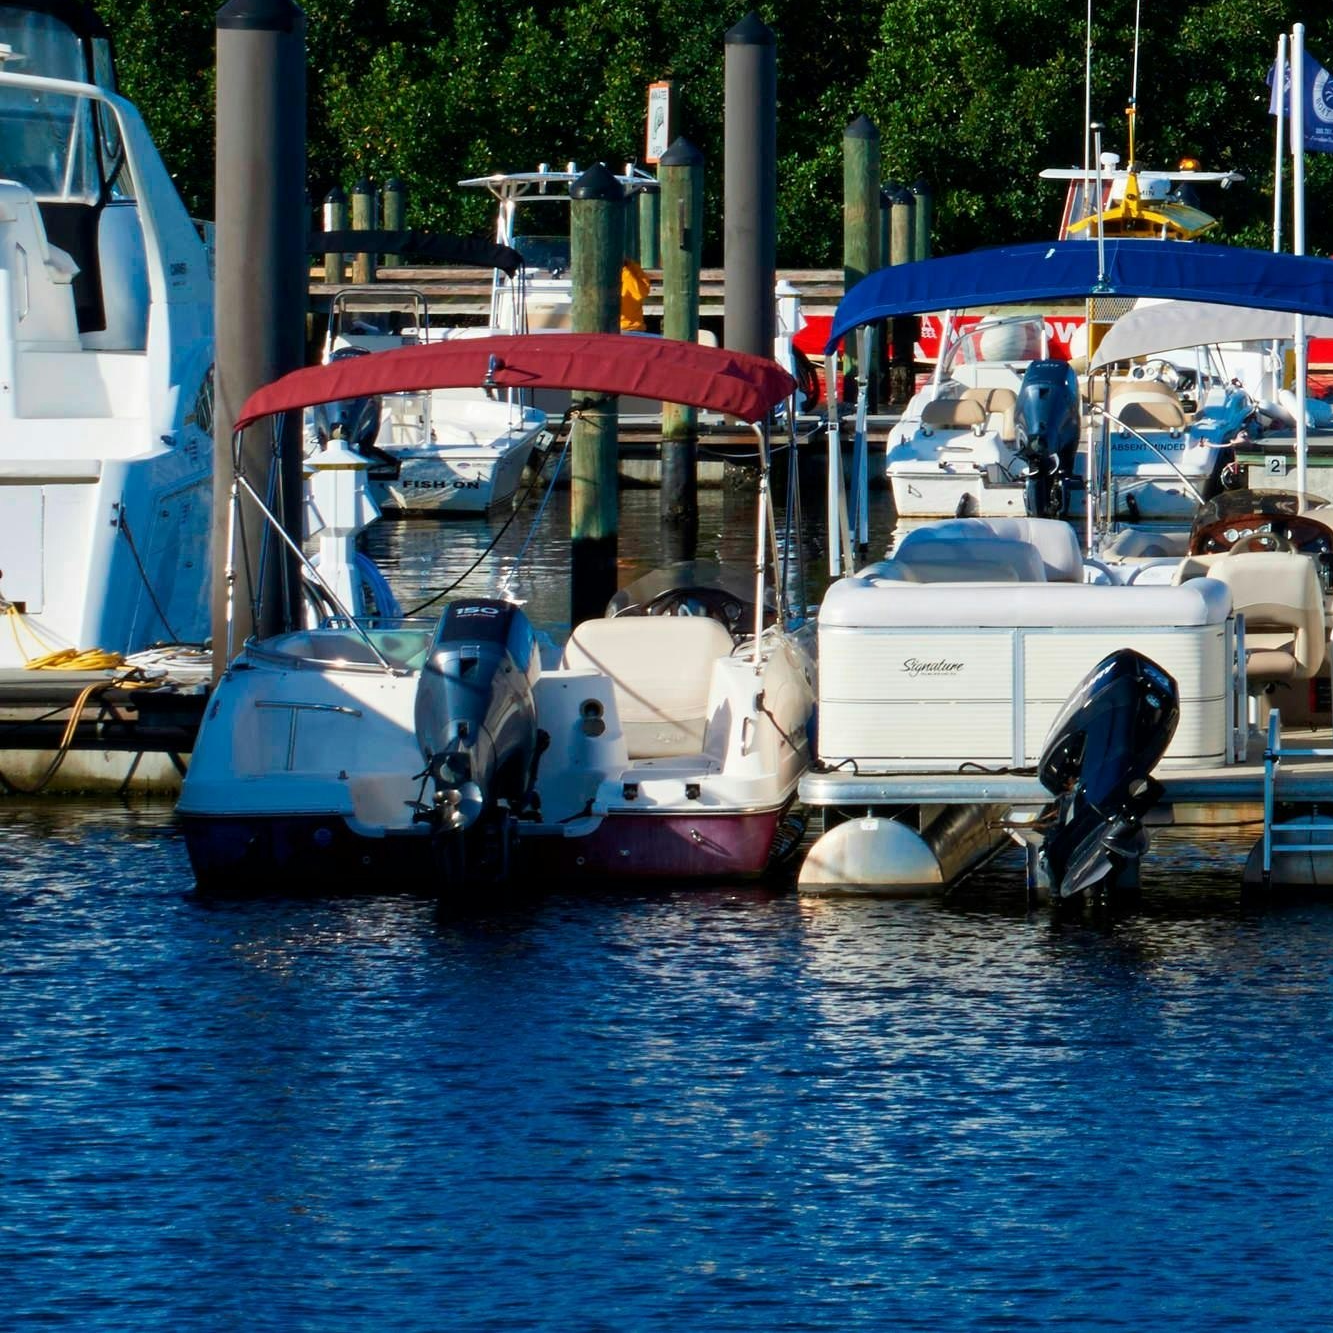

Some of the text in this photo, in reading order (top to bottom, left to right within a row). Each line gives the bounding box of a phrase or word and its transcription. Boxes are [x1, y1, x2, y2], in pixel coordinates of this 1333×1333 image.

[538, 434, 546, 446] 1
[1112, 443, 1147, 451] ABSENT
[1270, 459, 1281, 473] 2
[403, 480, 480, 489] FISH ON
[455, 606, 500, 615] 150
[899, 658, 965, 677] Signature
